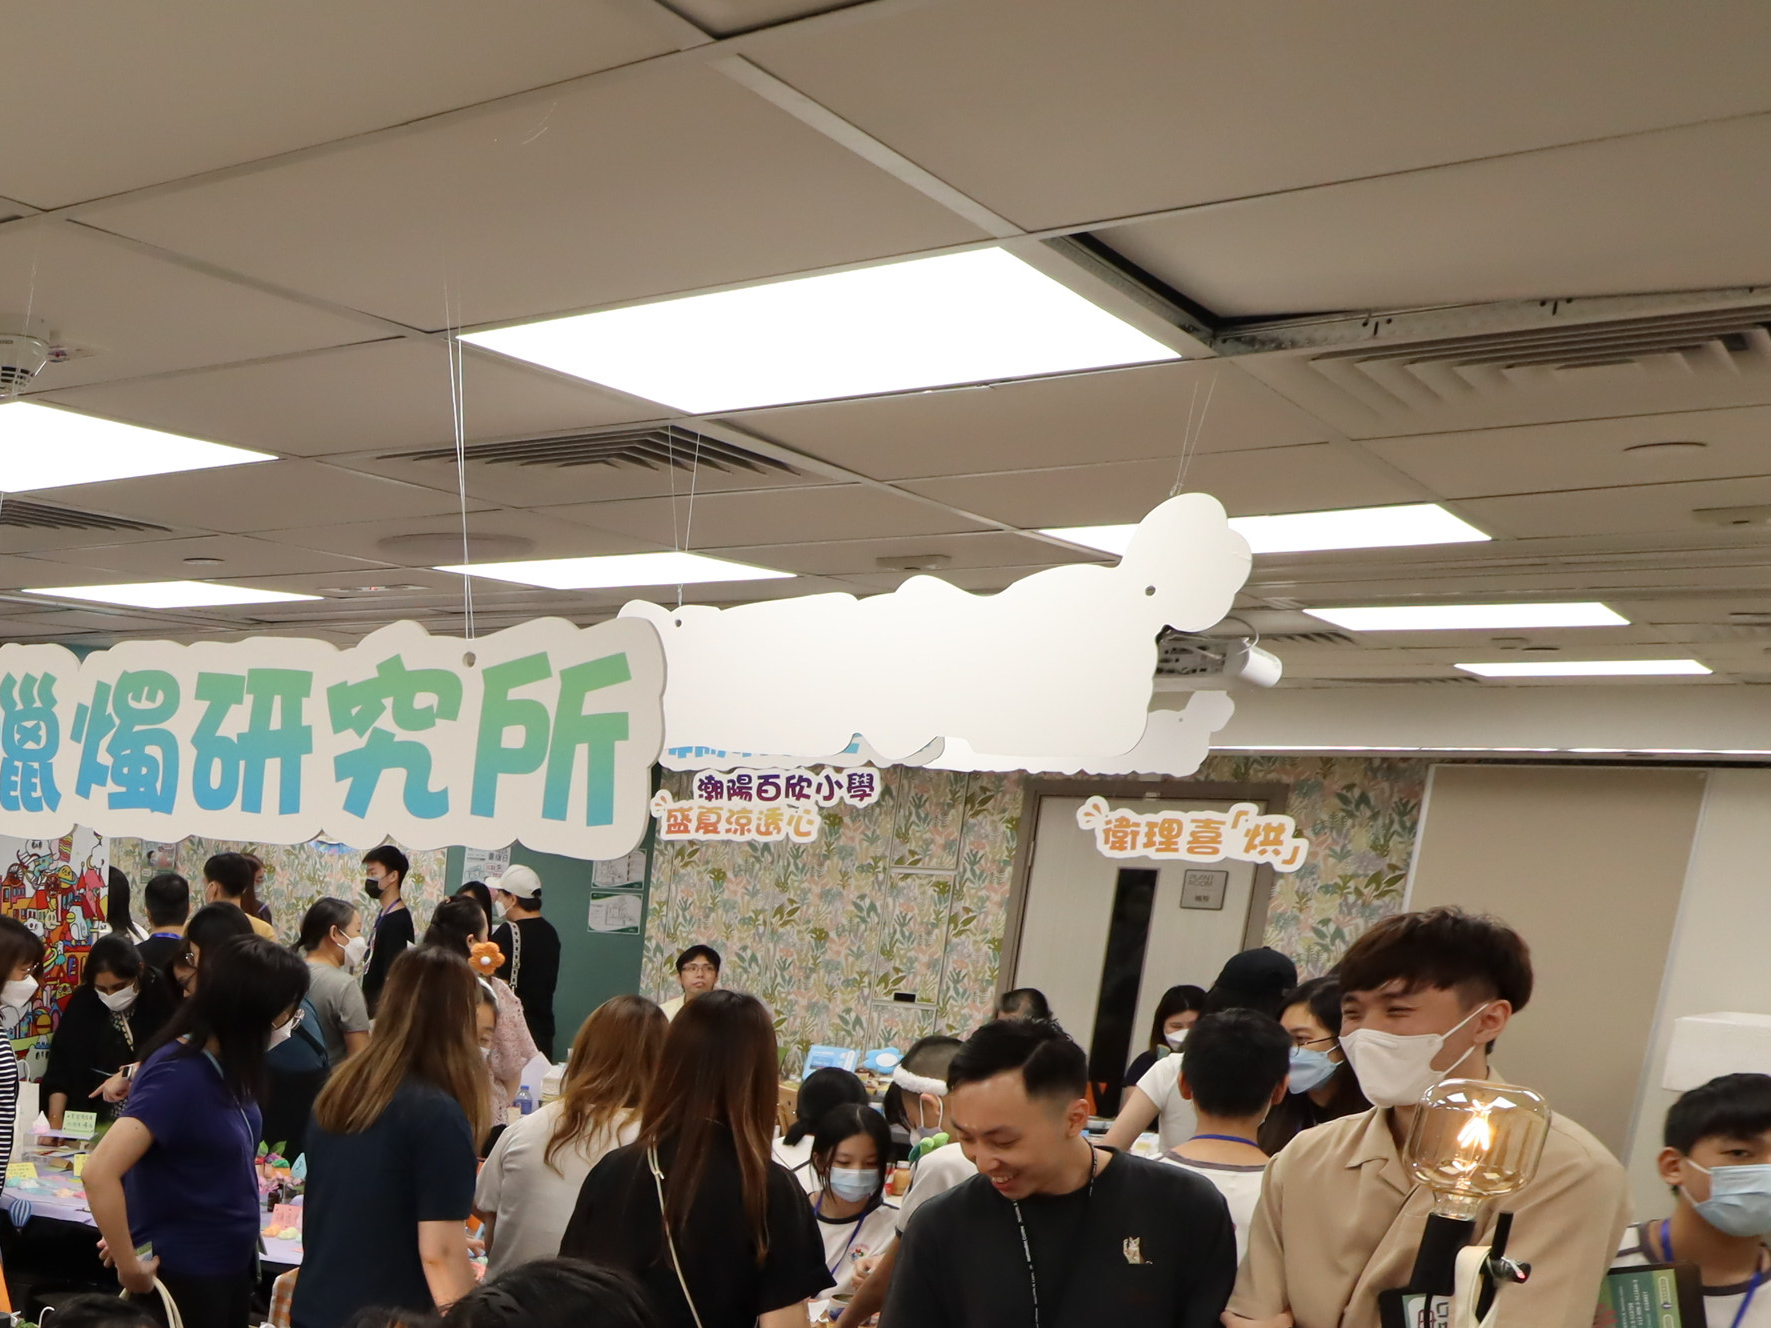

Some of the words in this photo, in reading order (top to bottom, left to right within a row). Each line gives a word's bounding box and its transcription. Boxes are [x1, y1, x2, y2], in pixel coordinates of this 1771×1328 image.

[697, 772, 875, 801] 潮陽百欣小學
[665, 806, 815, 837] 盛夏涼透心
